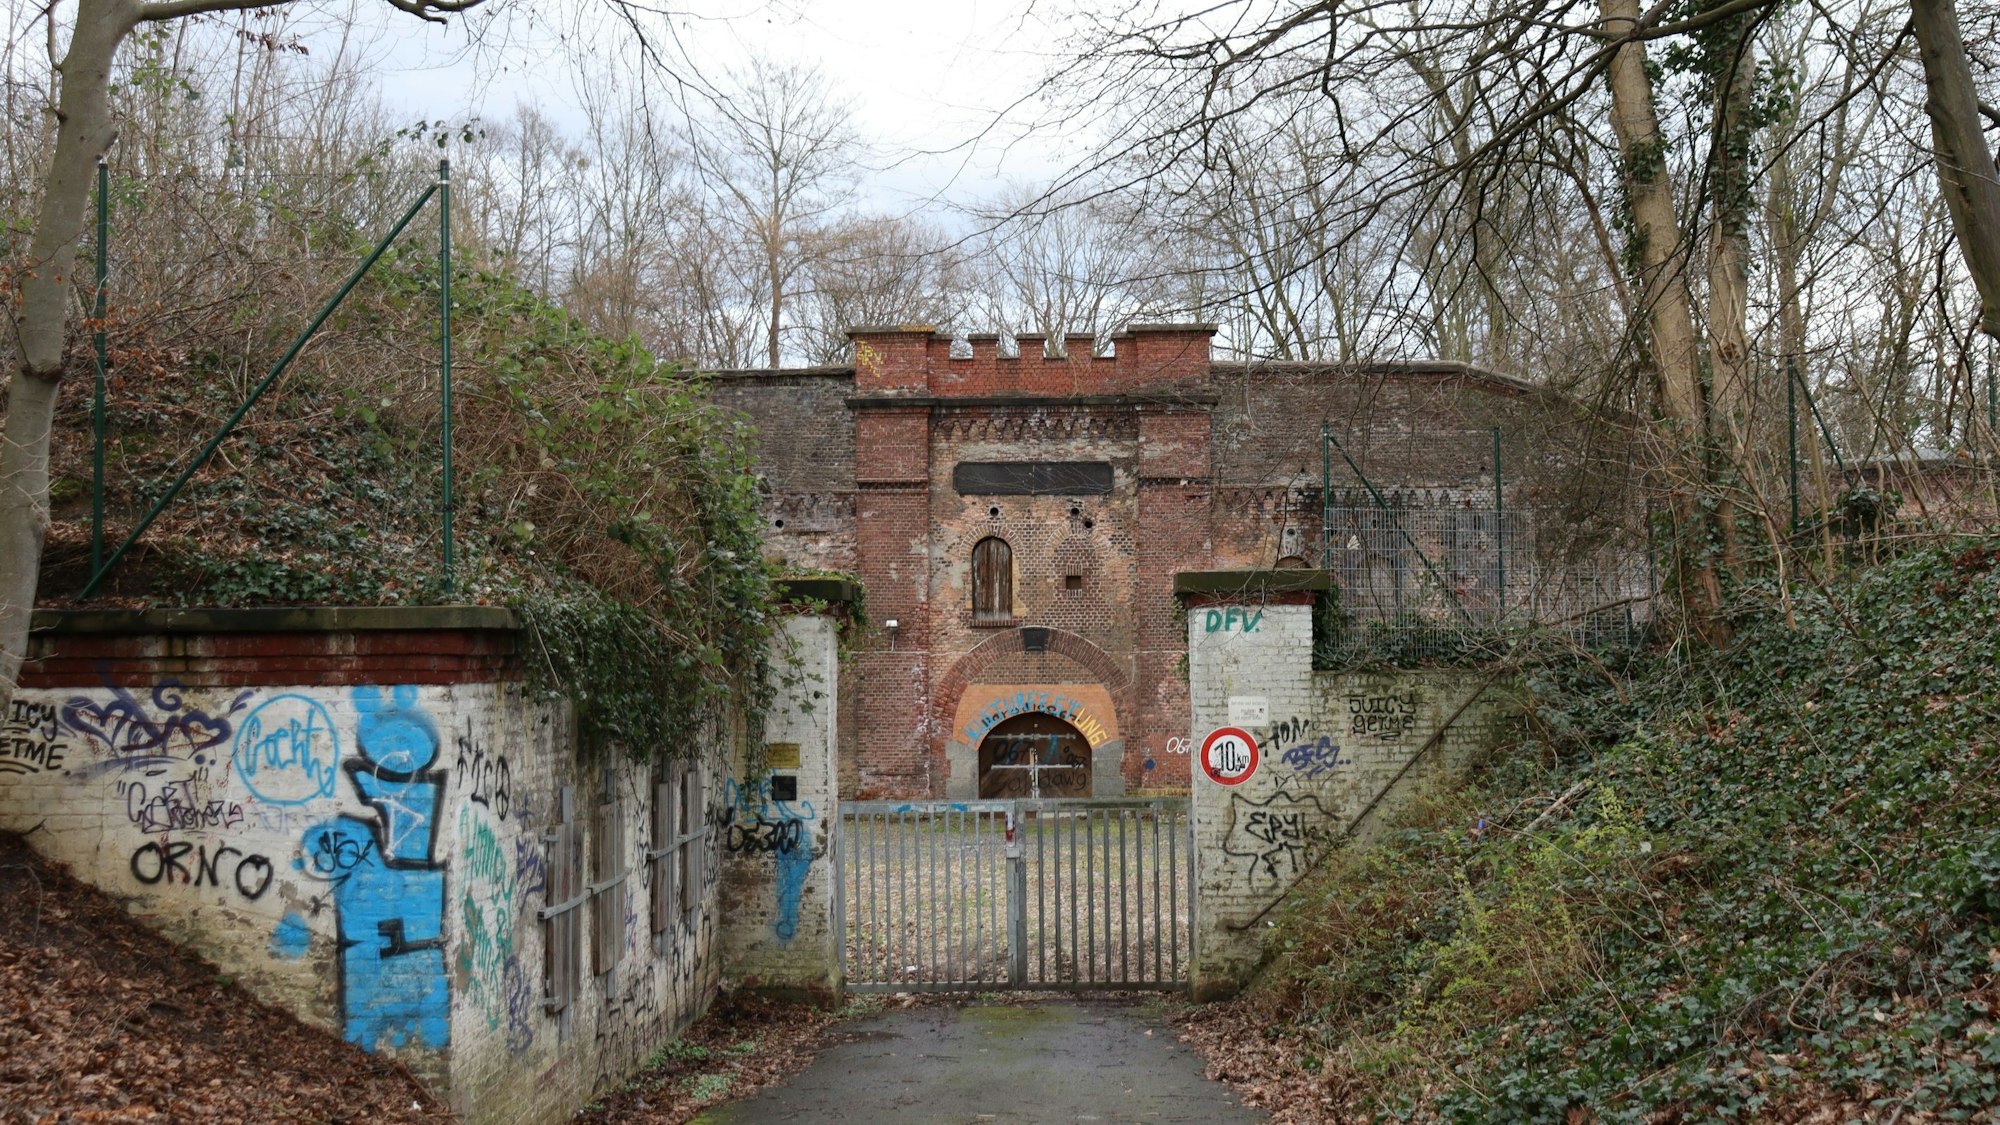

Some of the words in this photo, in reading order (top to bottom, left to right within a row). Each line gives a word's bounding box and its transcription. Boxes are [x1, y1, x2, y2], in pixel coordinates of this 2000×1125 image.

[1214, 740, 1236, 772] 10
[1236, 753, 1250, 764] km
[130, 840, 274, 900] ORNO
